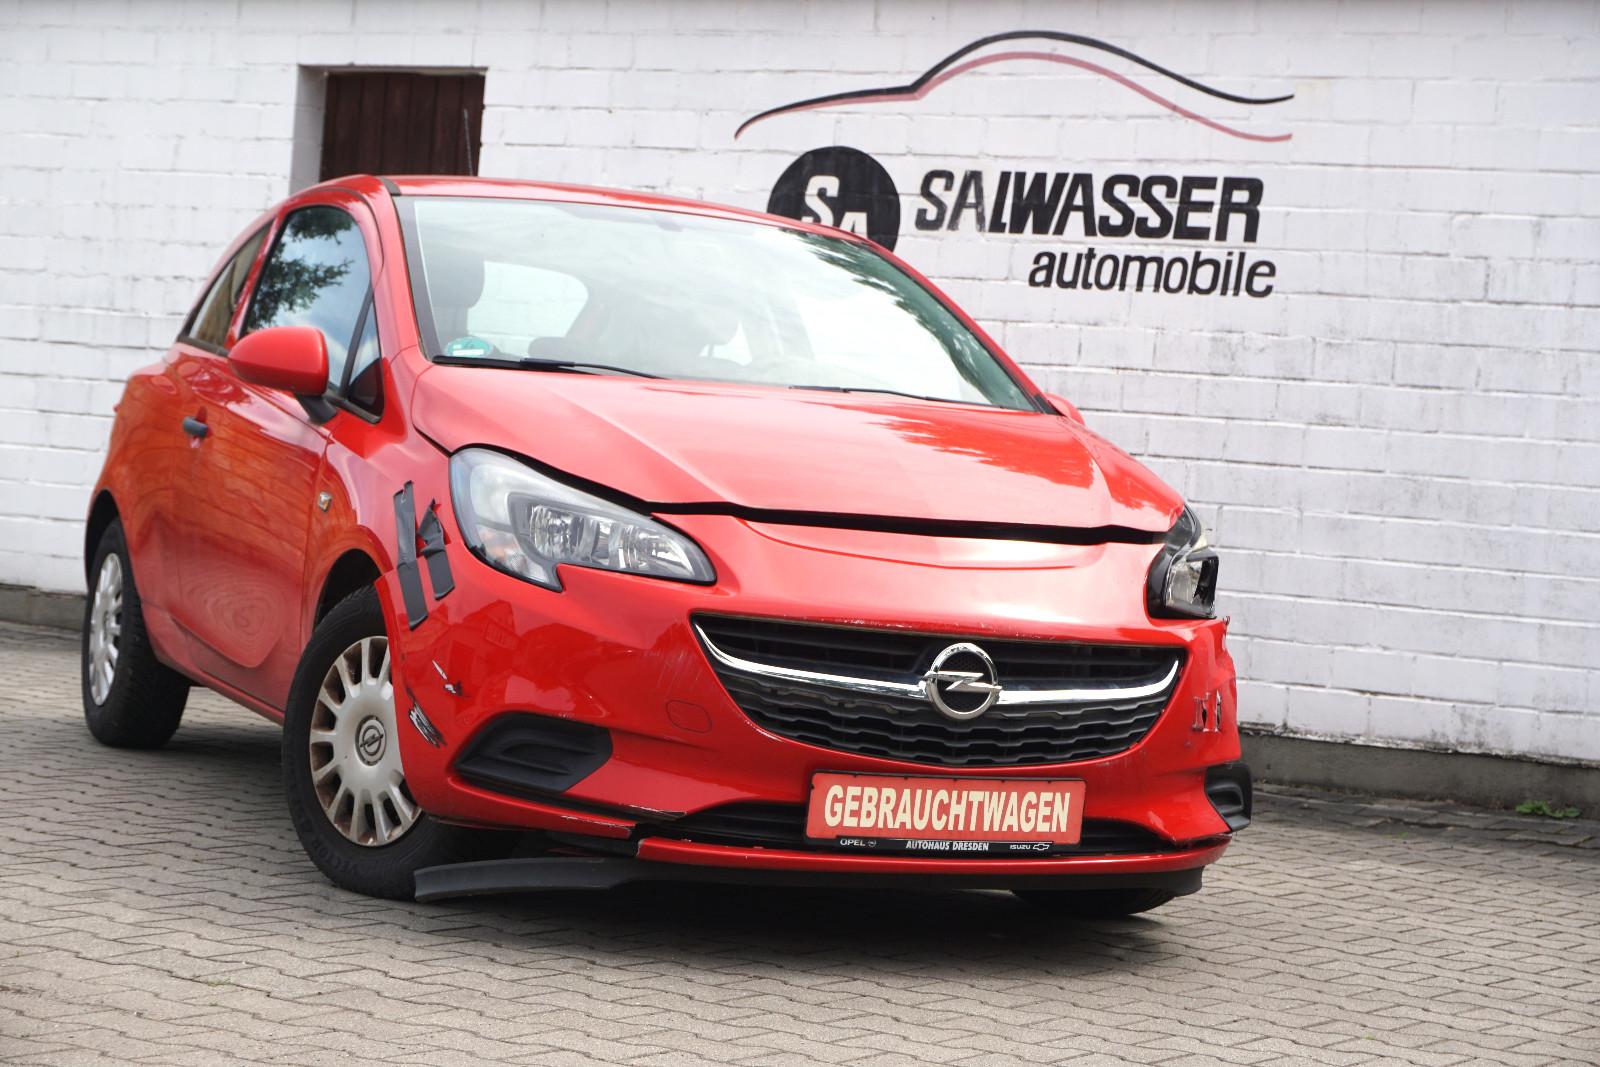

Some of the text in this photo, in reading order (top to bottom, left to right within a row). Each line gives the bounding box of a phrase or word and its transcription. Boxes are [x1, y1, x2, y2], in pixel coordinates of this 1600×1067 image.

[914, 170, 1264, 243] SALWASSER
[1028, 247, 1276, 297] automobile
[824, 784, 1071, 833] GEBRAUCHTWAGEN
[840, 838, 865, 847] OPEL
[905, 840, 989, 851] AUTOHAUS DRESDEN
